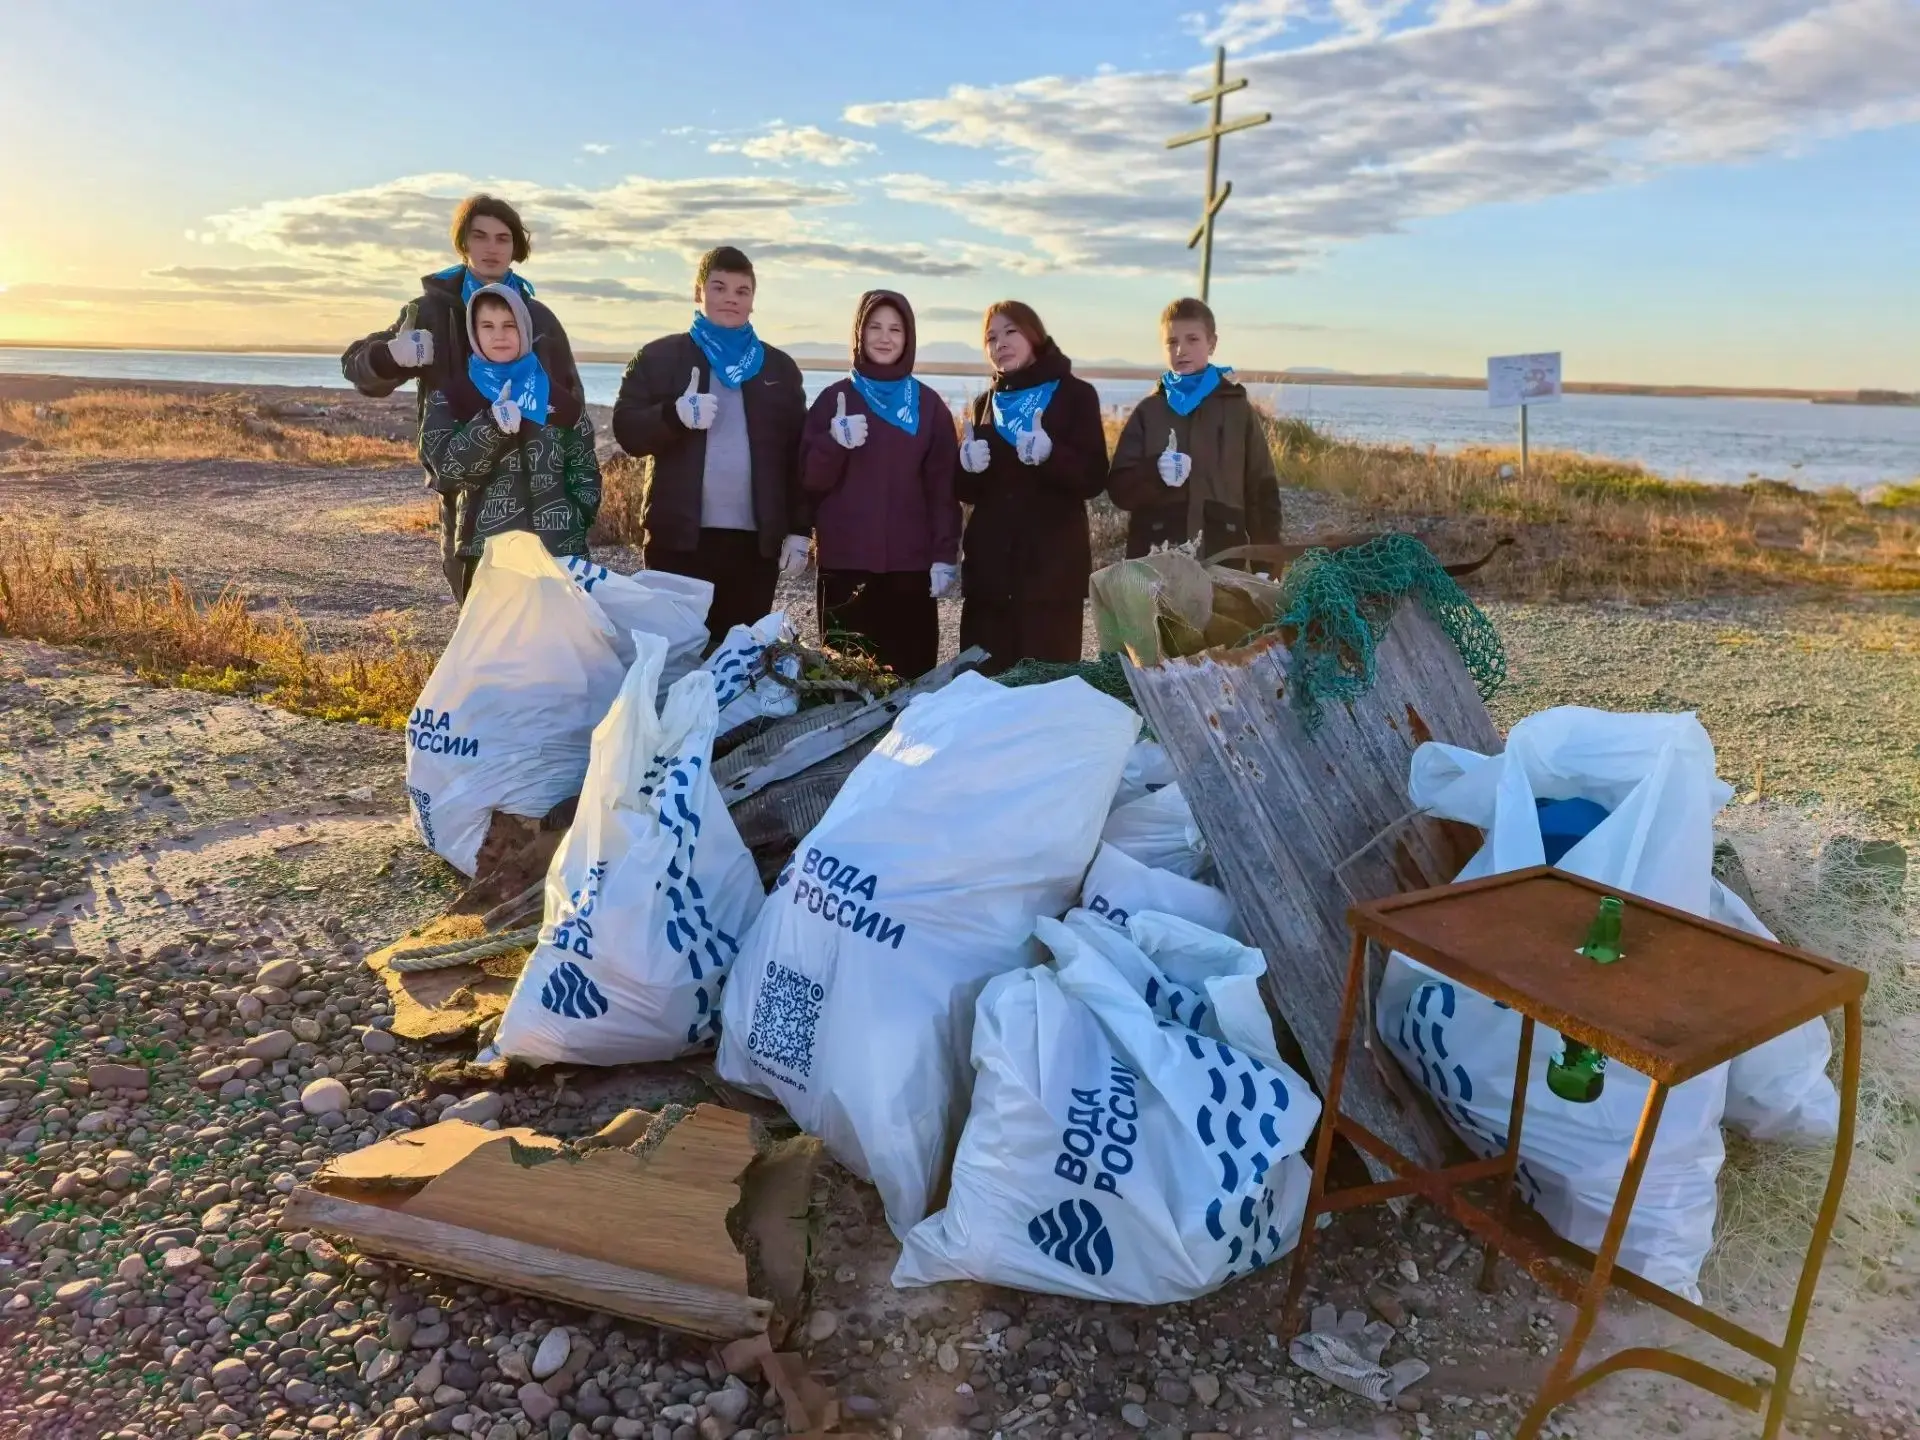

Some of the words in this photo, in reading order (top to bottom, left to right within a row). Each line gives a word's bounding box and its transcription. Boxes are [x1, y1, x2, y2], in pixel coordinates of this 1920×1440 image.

[482, 497, 517, 518] NIKE
[802, 847, 877, 901] ВОДА
[793, 879, 906, 950] РОССИИ
[1055, 1087, 1105, 1186] ВОДА
